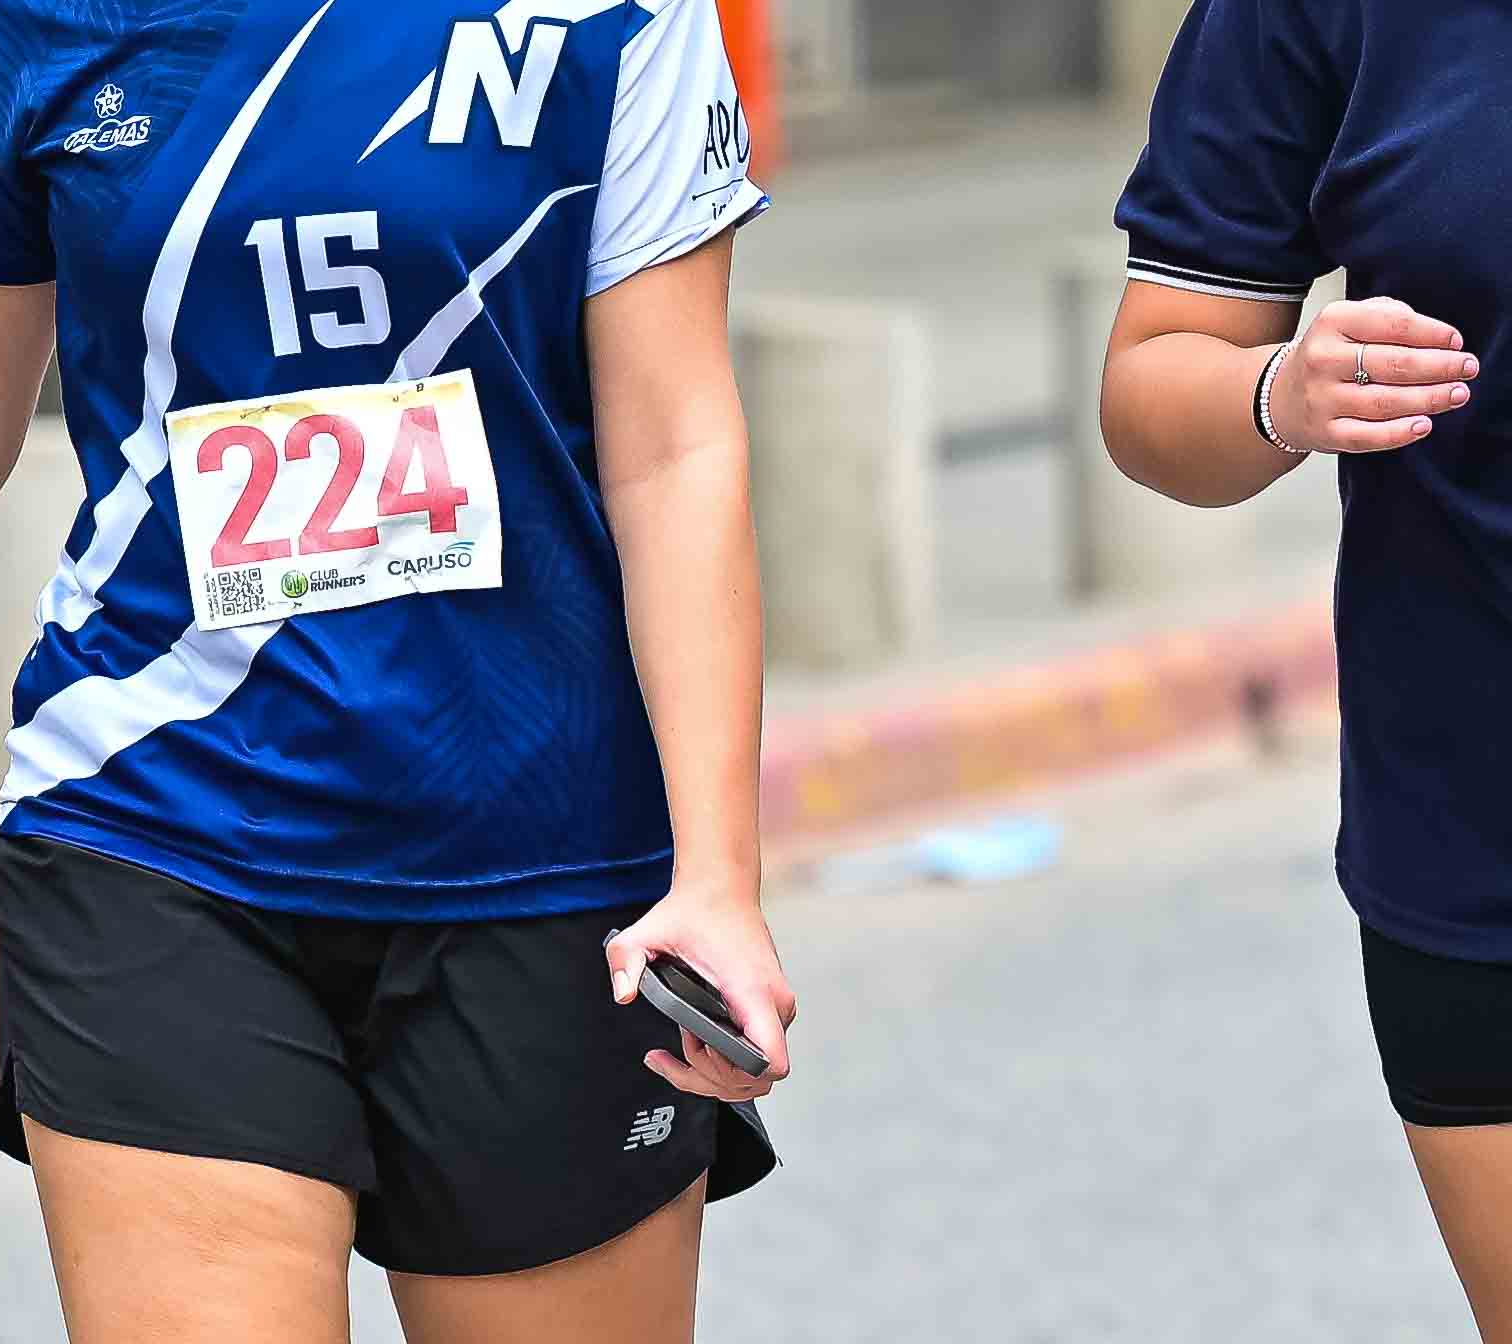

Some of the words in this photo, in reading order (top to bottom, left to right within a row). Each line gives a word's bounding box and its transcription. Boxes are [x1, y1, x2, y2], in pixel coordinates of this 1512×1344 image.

[427, 20, 569, 148] N
[244, 210, 393, 357] 15
[196, 405, 469, 569] 224
[309, 568, 339, 582] CLUB
[310, 574, 366, 593] RUNNER'S
[387, 552, 472, 576] CARUSO
